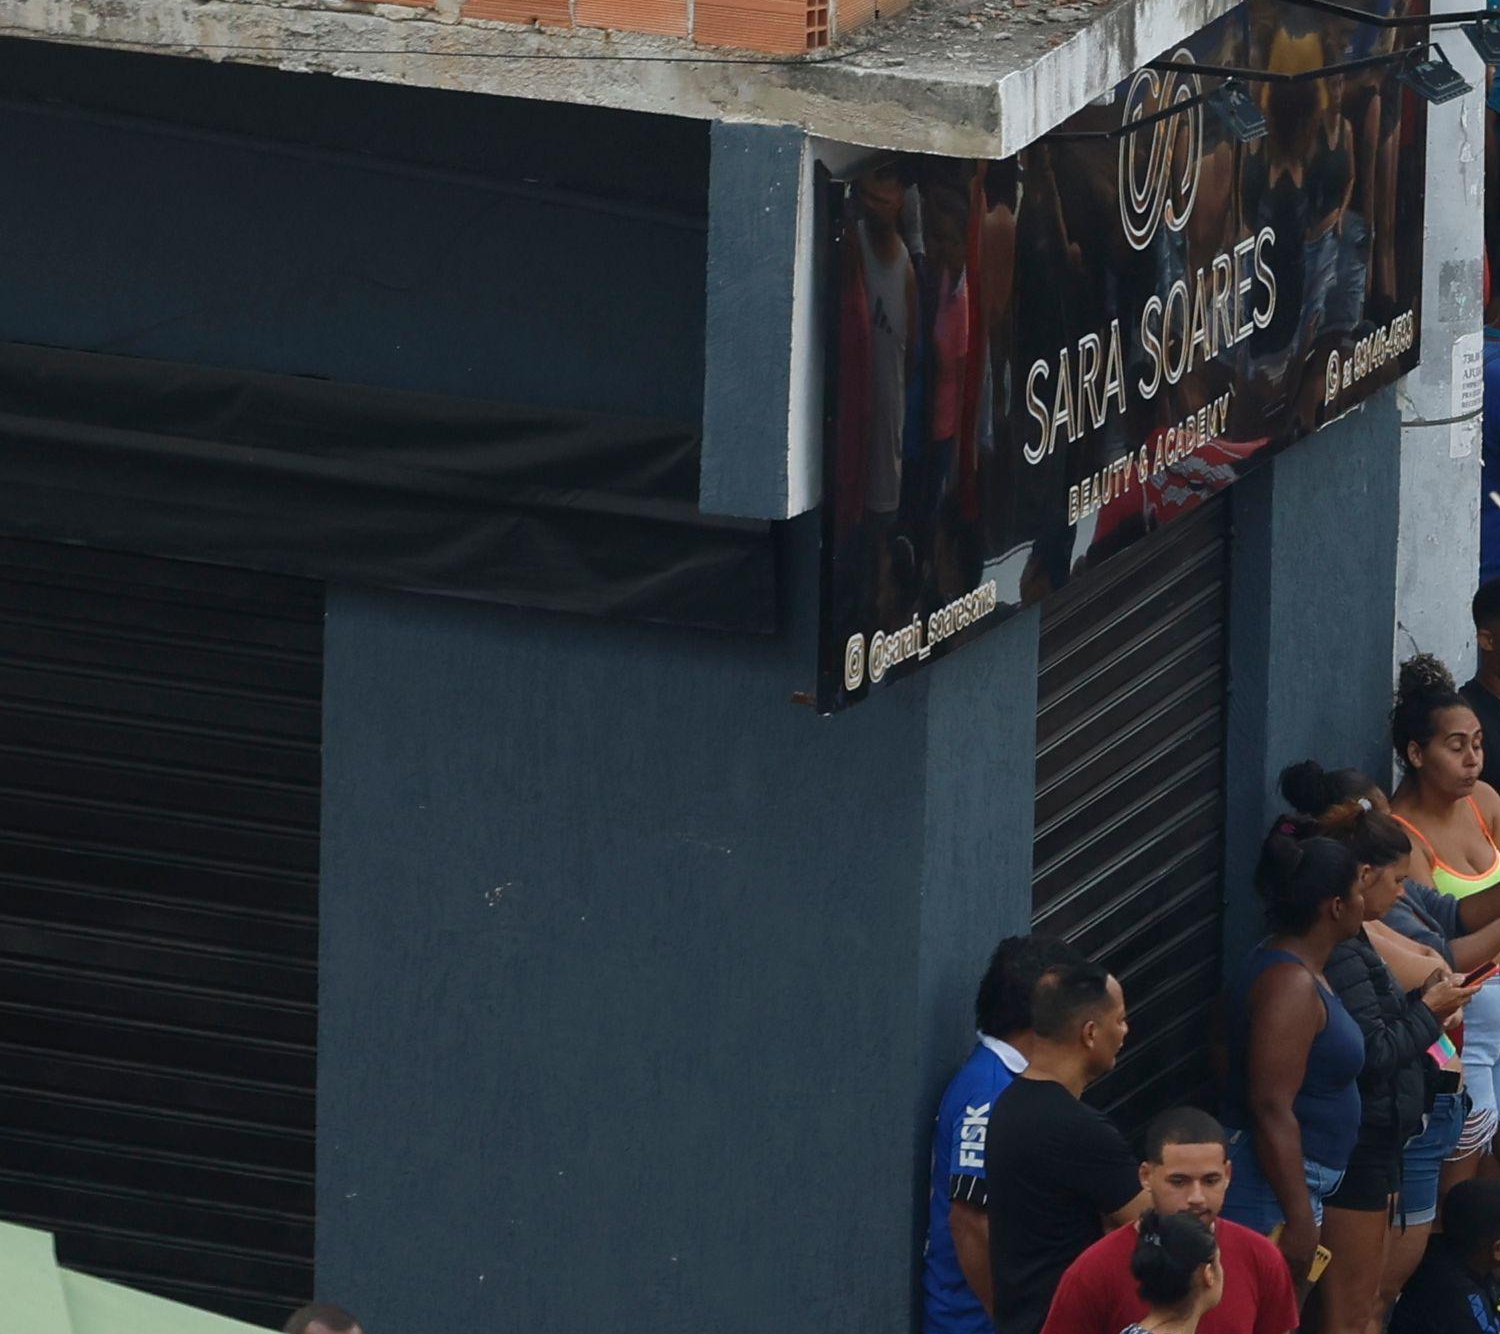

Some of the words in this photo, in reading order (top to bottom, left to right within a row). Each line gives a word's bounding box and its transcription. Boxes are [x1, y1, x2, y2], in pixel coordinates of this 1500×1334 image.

[1023, 318, 1127, 465] SARA
[1138, 226, 1277, 400] SOARES
[1068, 451, 1134, 527] BEAUTY
[1153, 392, 1231, 476] ACADEMY
[959, 1102, 991, 1169] FISK
